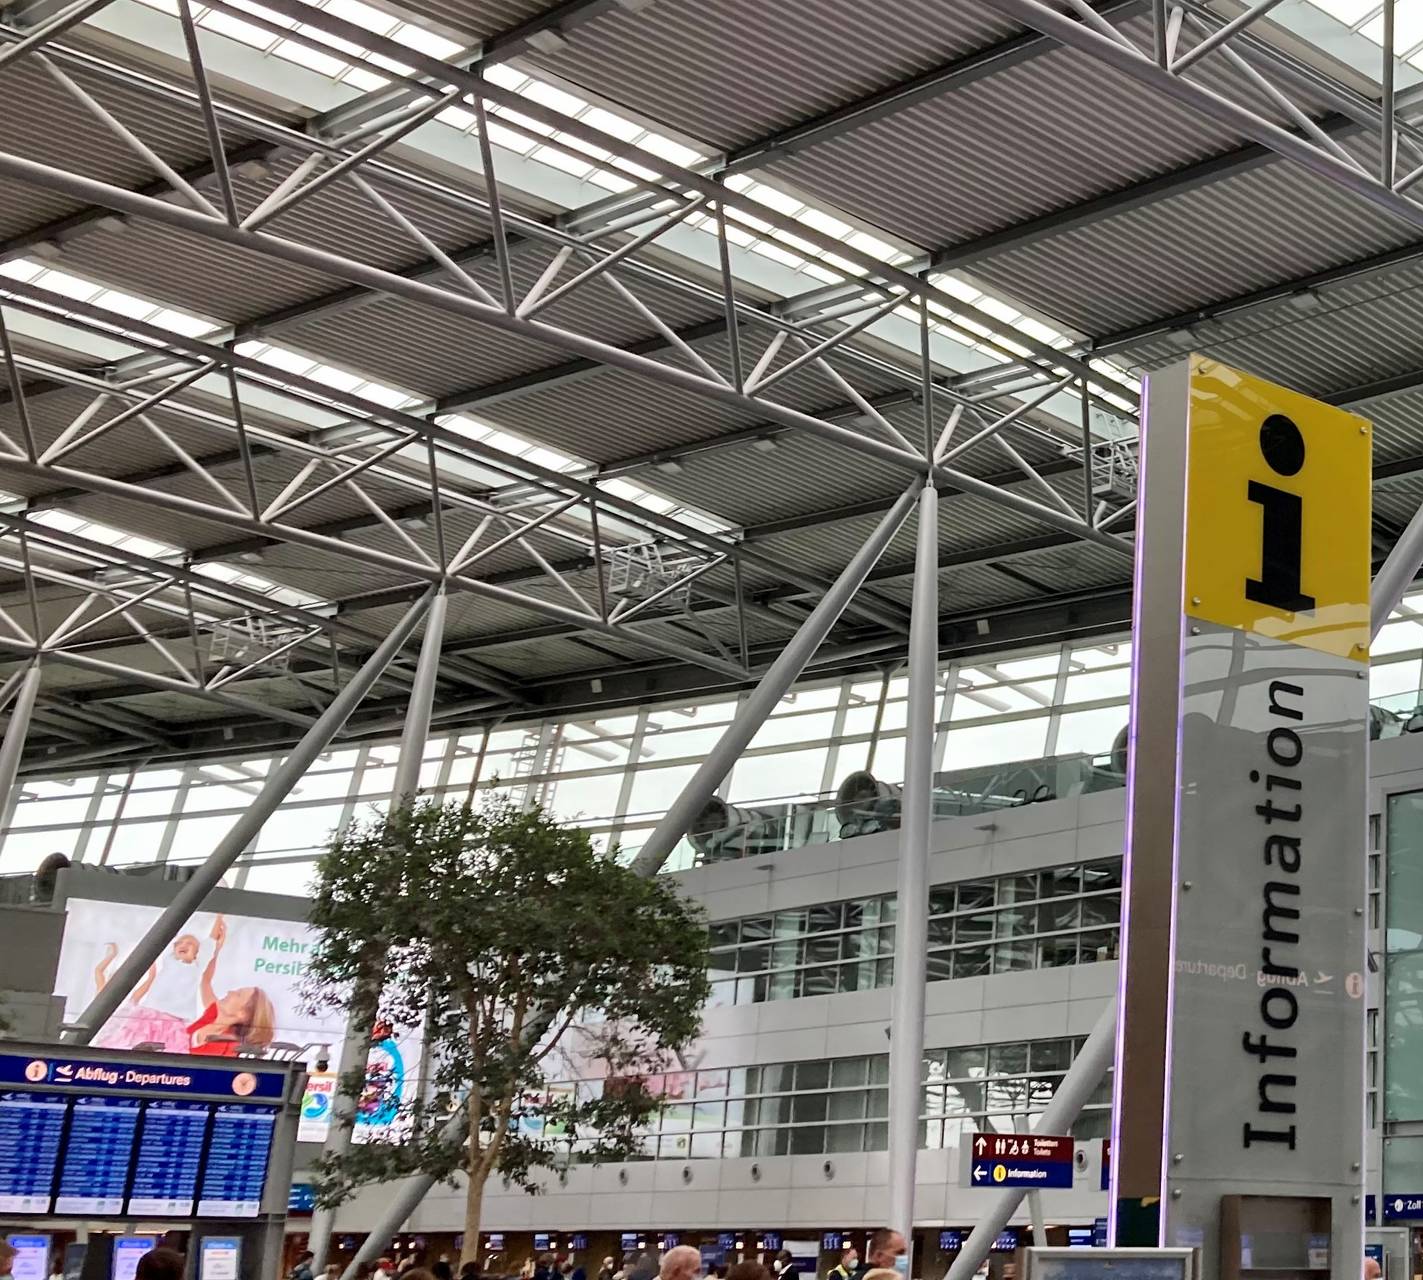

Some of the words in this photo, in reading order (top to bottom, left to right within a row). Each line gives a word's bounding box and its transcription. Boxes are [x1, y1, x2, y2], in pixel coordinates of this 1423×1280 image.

[1243, 679, 1304, 1150] Information
[262, 936, 307, 953] Mehr
[74, 1067, 118, 1085] Abflug
[125, 1069, 191, 1087] Departures
[306, 1080, 333, 1093] ersil
[1008, 1168, 1047, 1178] Information
[1407, 1199, 1422, 1209] Zoll
